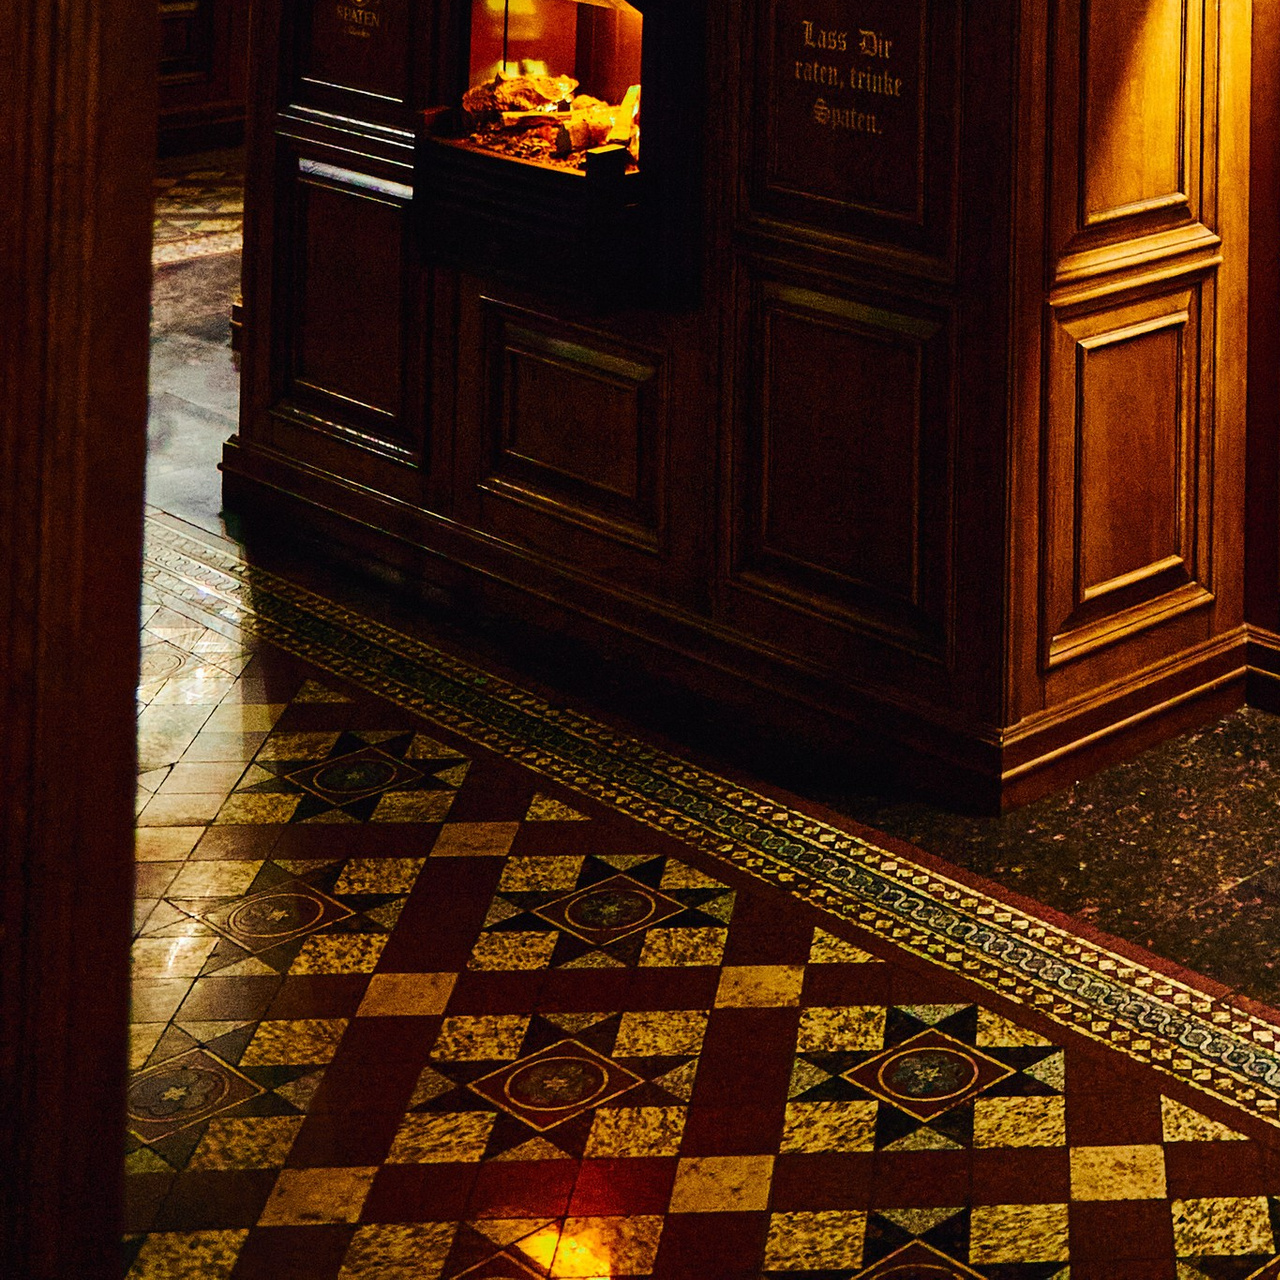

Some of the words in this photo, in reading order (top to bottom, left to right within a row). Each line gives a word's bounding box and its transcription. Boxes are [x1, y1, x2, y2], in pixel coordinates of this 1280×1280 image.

[801, 19, 848, 52] Lass
[858, 28, 893, 59] Dir
[794, 59, 844, 90] raten,
[849, 65, 903, 97] trinke
[812, 96, 884, 135] Spaten.
